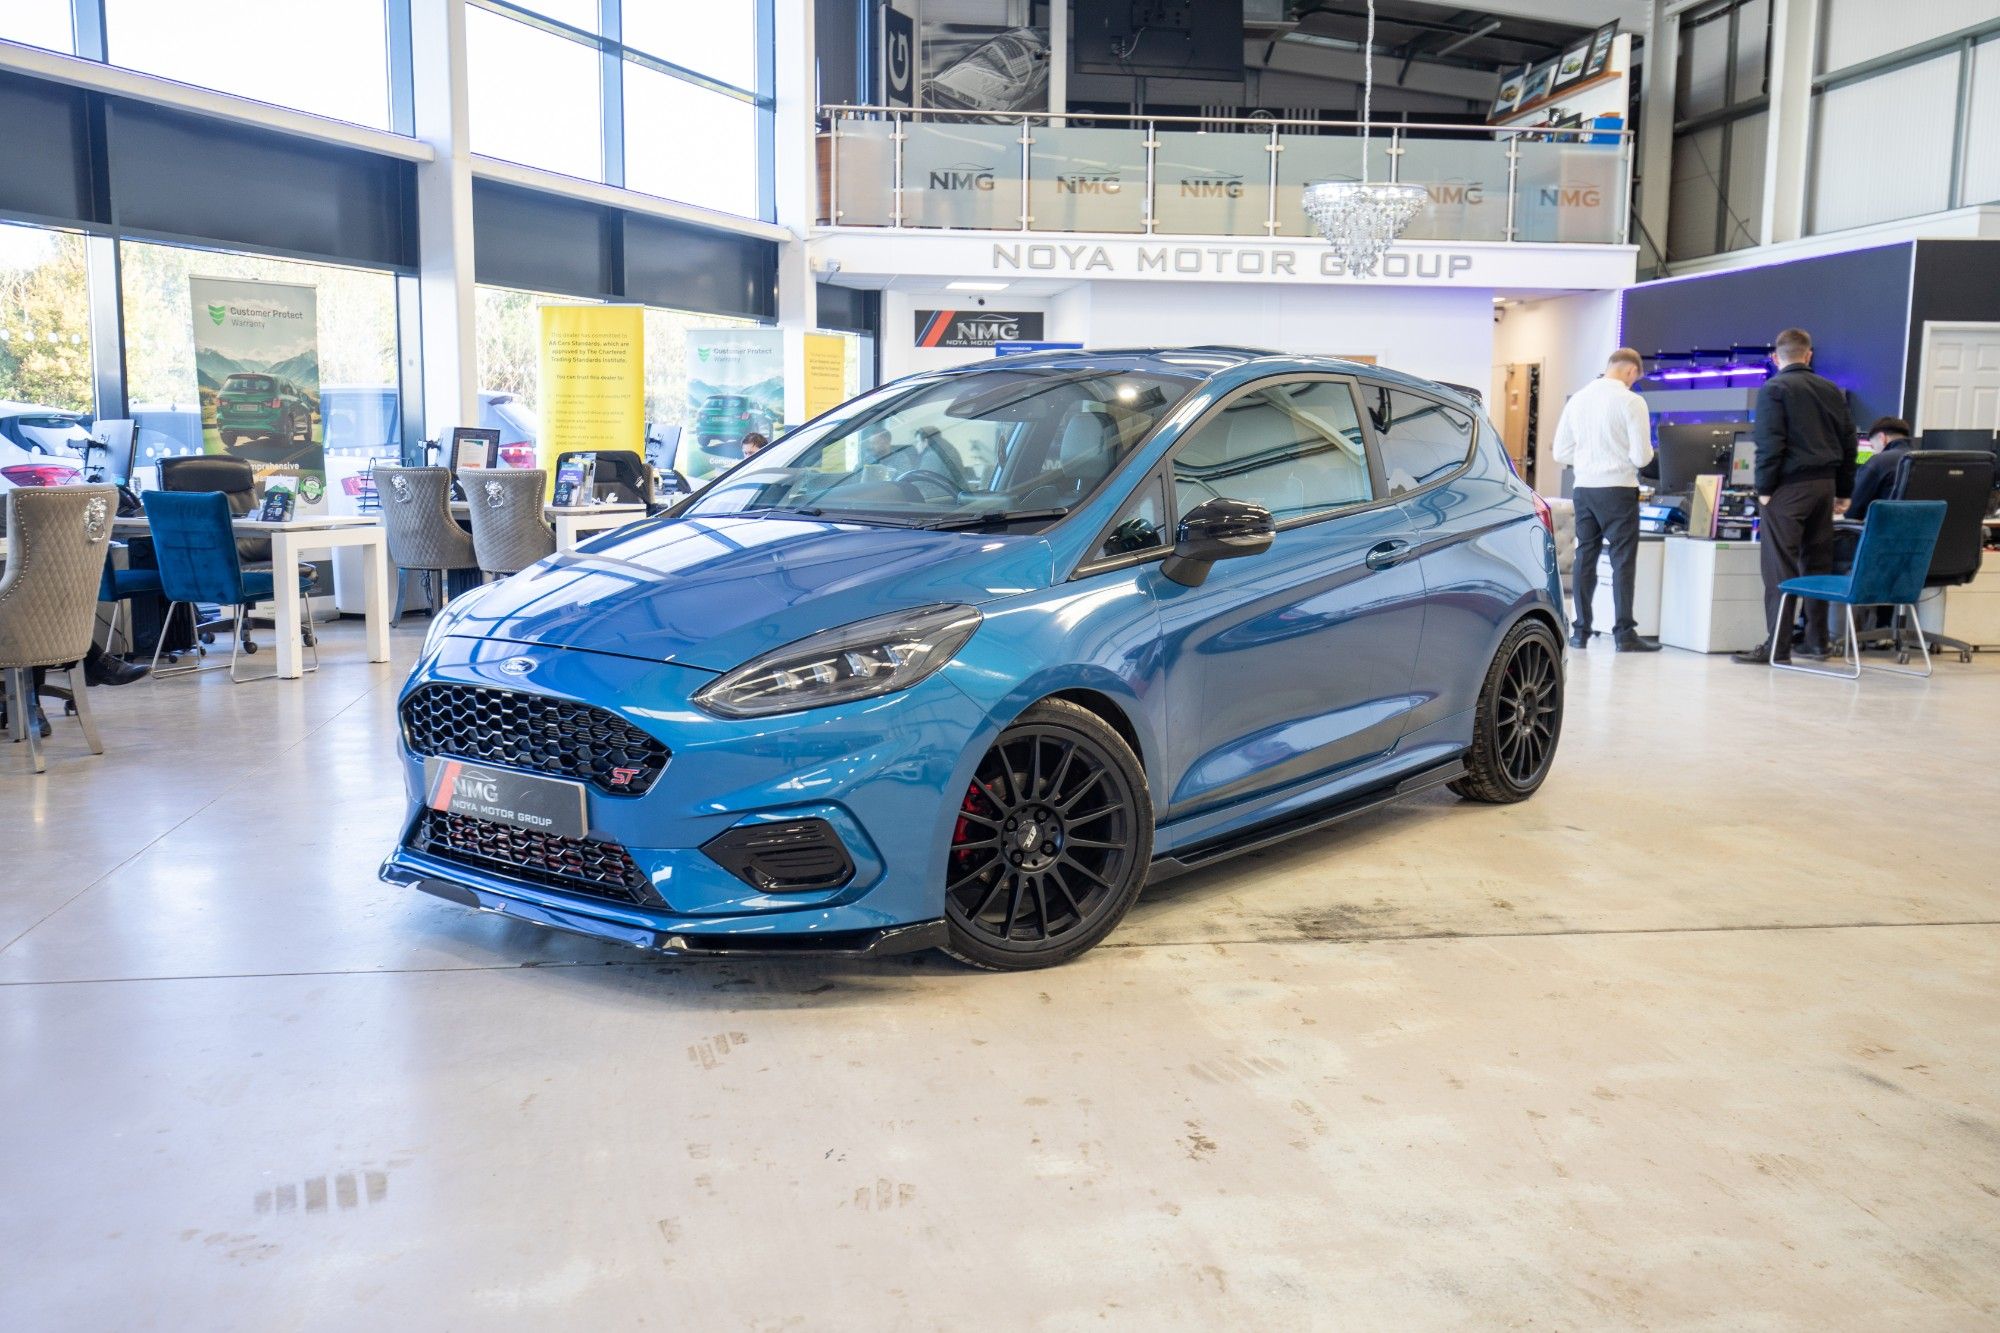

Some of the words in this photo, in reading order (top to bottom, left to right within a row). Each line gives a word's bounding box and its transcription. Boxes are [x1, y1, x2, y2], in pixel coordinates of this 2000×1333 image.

[929, 171, 994, 191] NMG
[1056, 176, 1121, 195] NMG
[1181, 179, 1244, 199] NMG
[1427, 187, 1483, 206] NMG
[1540, 188, 1601, 207] NMG
[993, 243, 1114, 271] NOYA
[1138, 246, 1296, 275] MOTOR
[230, 307, 271, 317] Customer
[273, 309, 304, 319] Protect
[231, 319, 266, 329] Warranty
[957, 322, 1019, 340] NMG
[611, 767, 640, 785] ST
[452, 777, 498, 803] NMG
[452, 799, 478, 812] NOYA
[480, 805, 514, 820] MOTOR
[517, 812, 553, 827] GROUP
